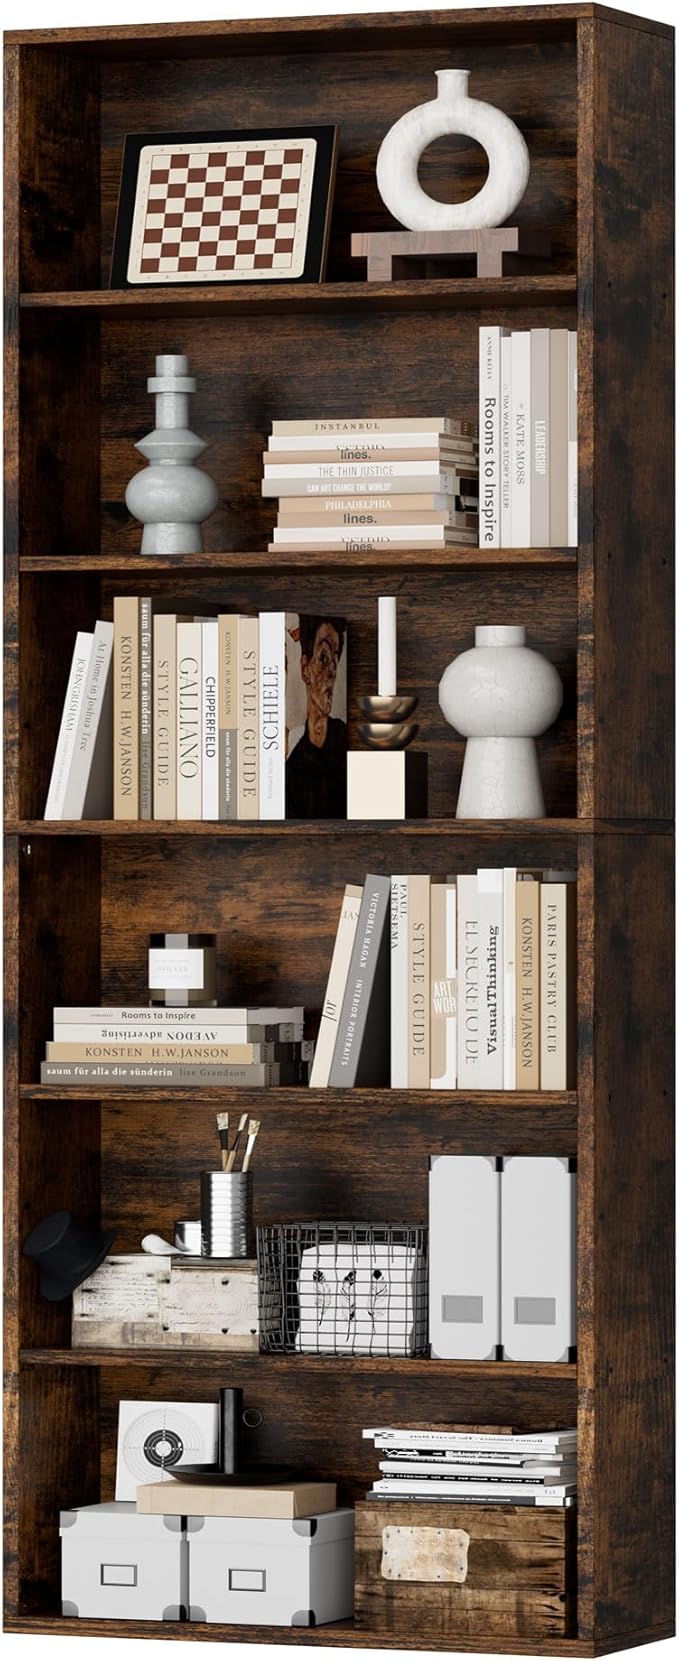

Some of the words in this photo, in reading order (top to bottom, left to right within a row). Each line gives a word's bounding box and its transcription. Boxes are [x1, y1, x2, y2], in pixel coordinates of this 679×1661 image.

[315, 423, 380, 431] INSTANBUL
[484, 397, 497, 455] Rooms
[516, 414, 526, 447] KATE
[340, 449, 371, 460] lines.
[534, 420, 546, 475] LEADERSHIP
[319, 467, 334, 476] THE
[337, 466, 357, 476] THIN
[359, 465, 394, 476] JUSTICE
[484, 460, 496, 477] to
[516, 450, 526, 485] MOSS
[325, 500, 391, 510] PHILADELPHIA
[343, 513, 377, 524] lines.
[481, 483, 497, 543] Inspire
[345, 542, 376, 551] lines.
[141, 603, 149, 629] saum
[97, 639, 107, 652] At
[141, 632, 152, 648] für
[224, 631, 232, 665] KONSTEN
[91, 655, 106, 683] Home
[120, 635, 132, 700] KONSTEN
[141, 650, 152, 669] alla
[90, 685, 99, 694] in
[141, 671, 152, 688] die
[157, 659, 169, 718] STYLE
[224, 670, 232, 716] H.W.JANSON
[242, 650, 256, 718] STYLE
[83, 695, 99, 729] Joshua
[141, 690, 152, 735] sünderin
[179, 656, 199, 779] GALLIANO
[205, 676, 216, 758] CHIPPERFIELD
[262, 665, 279, 751] SCHIELE
[79, 731, 92, 752] Tree
[118, 710, 132, 797] H.W.JANSON
[157, 727, 169, 787] GUIDE
[242, 729, 256, 798] GUIDE
[366, 892, 380, 934] VICTORIA
[391, 883, 399, 950] SIETSEMA
[400, 883, 408, 918] PAUL
[547, 904, 557, 948] PARIS
[359, 937, 372, 969] HAGAN
[412, 922, 425, 984] STYLE
[521, 917, 533, 978] KONSTEN
[434, 981, 452, 997] ART
[486, 925, 500, 1055] VisualThinking
[547, 953, 557, 1008] PASTRY
[121, 1011, 151, 1019] Rooms
[154, 1011, 163, 1019] to
[165, 1011, 196, 1021] Inspire
[350, 979, 364, 1019] INTERIOR
[101, 1029, 163, 1040] advertising
[166, 1032, 218, 1041] AVEDON
[412, 993, 425, 1057] GUIDE
[520, 986, 533, 1069] H.W.JANSON
[547, 1014, 557, 1054] CLUB
[85, 1047, 143, 1057] KONSTEN
[151, 1047, 229, 1059] H.W.JANSON
[341, 1021, 356, 1066] PORTRAITS
[74, 1067, 89, 1075] für
[91, 1067, 109, 1076] alla
[111, 1067, 127, 1076] die
[129, 1067, 173, 1077] sünderin
